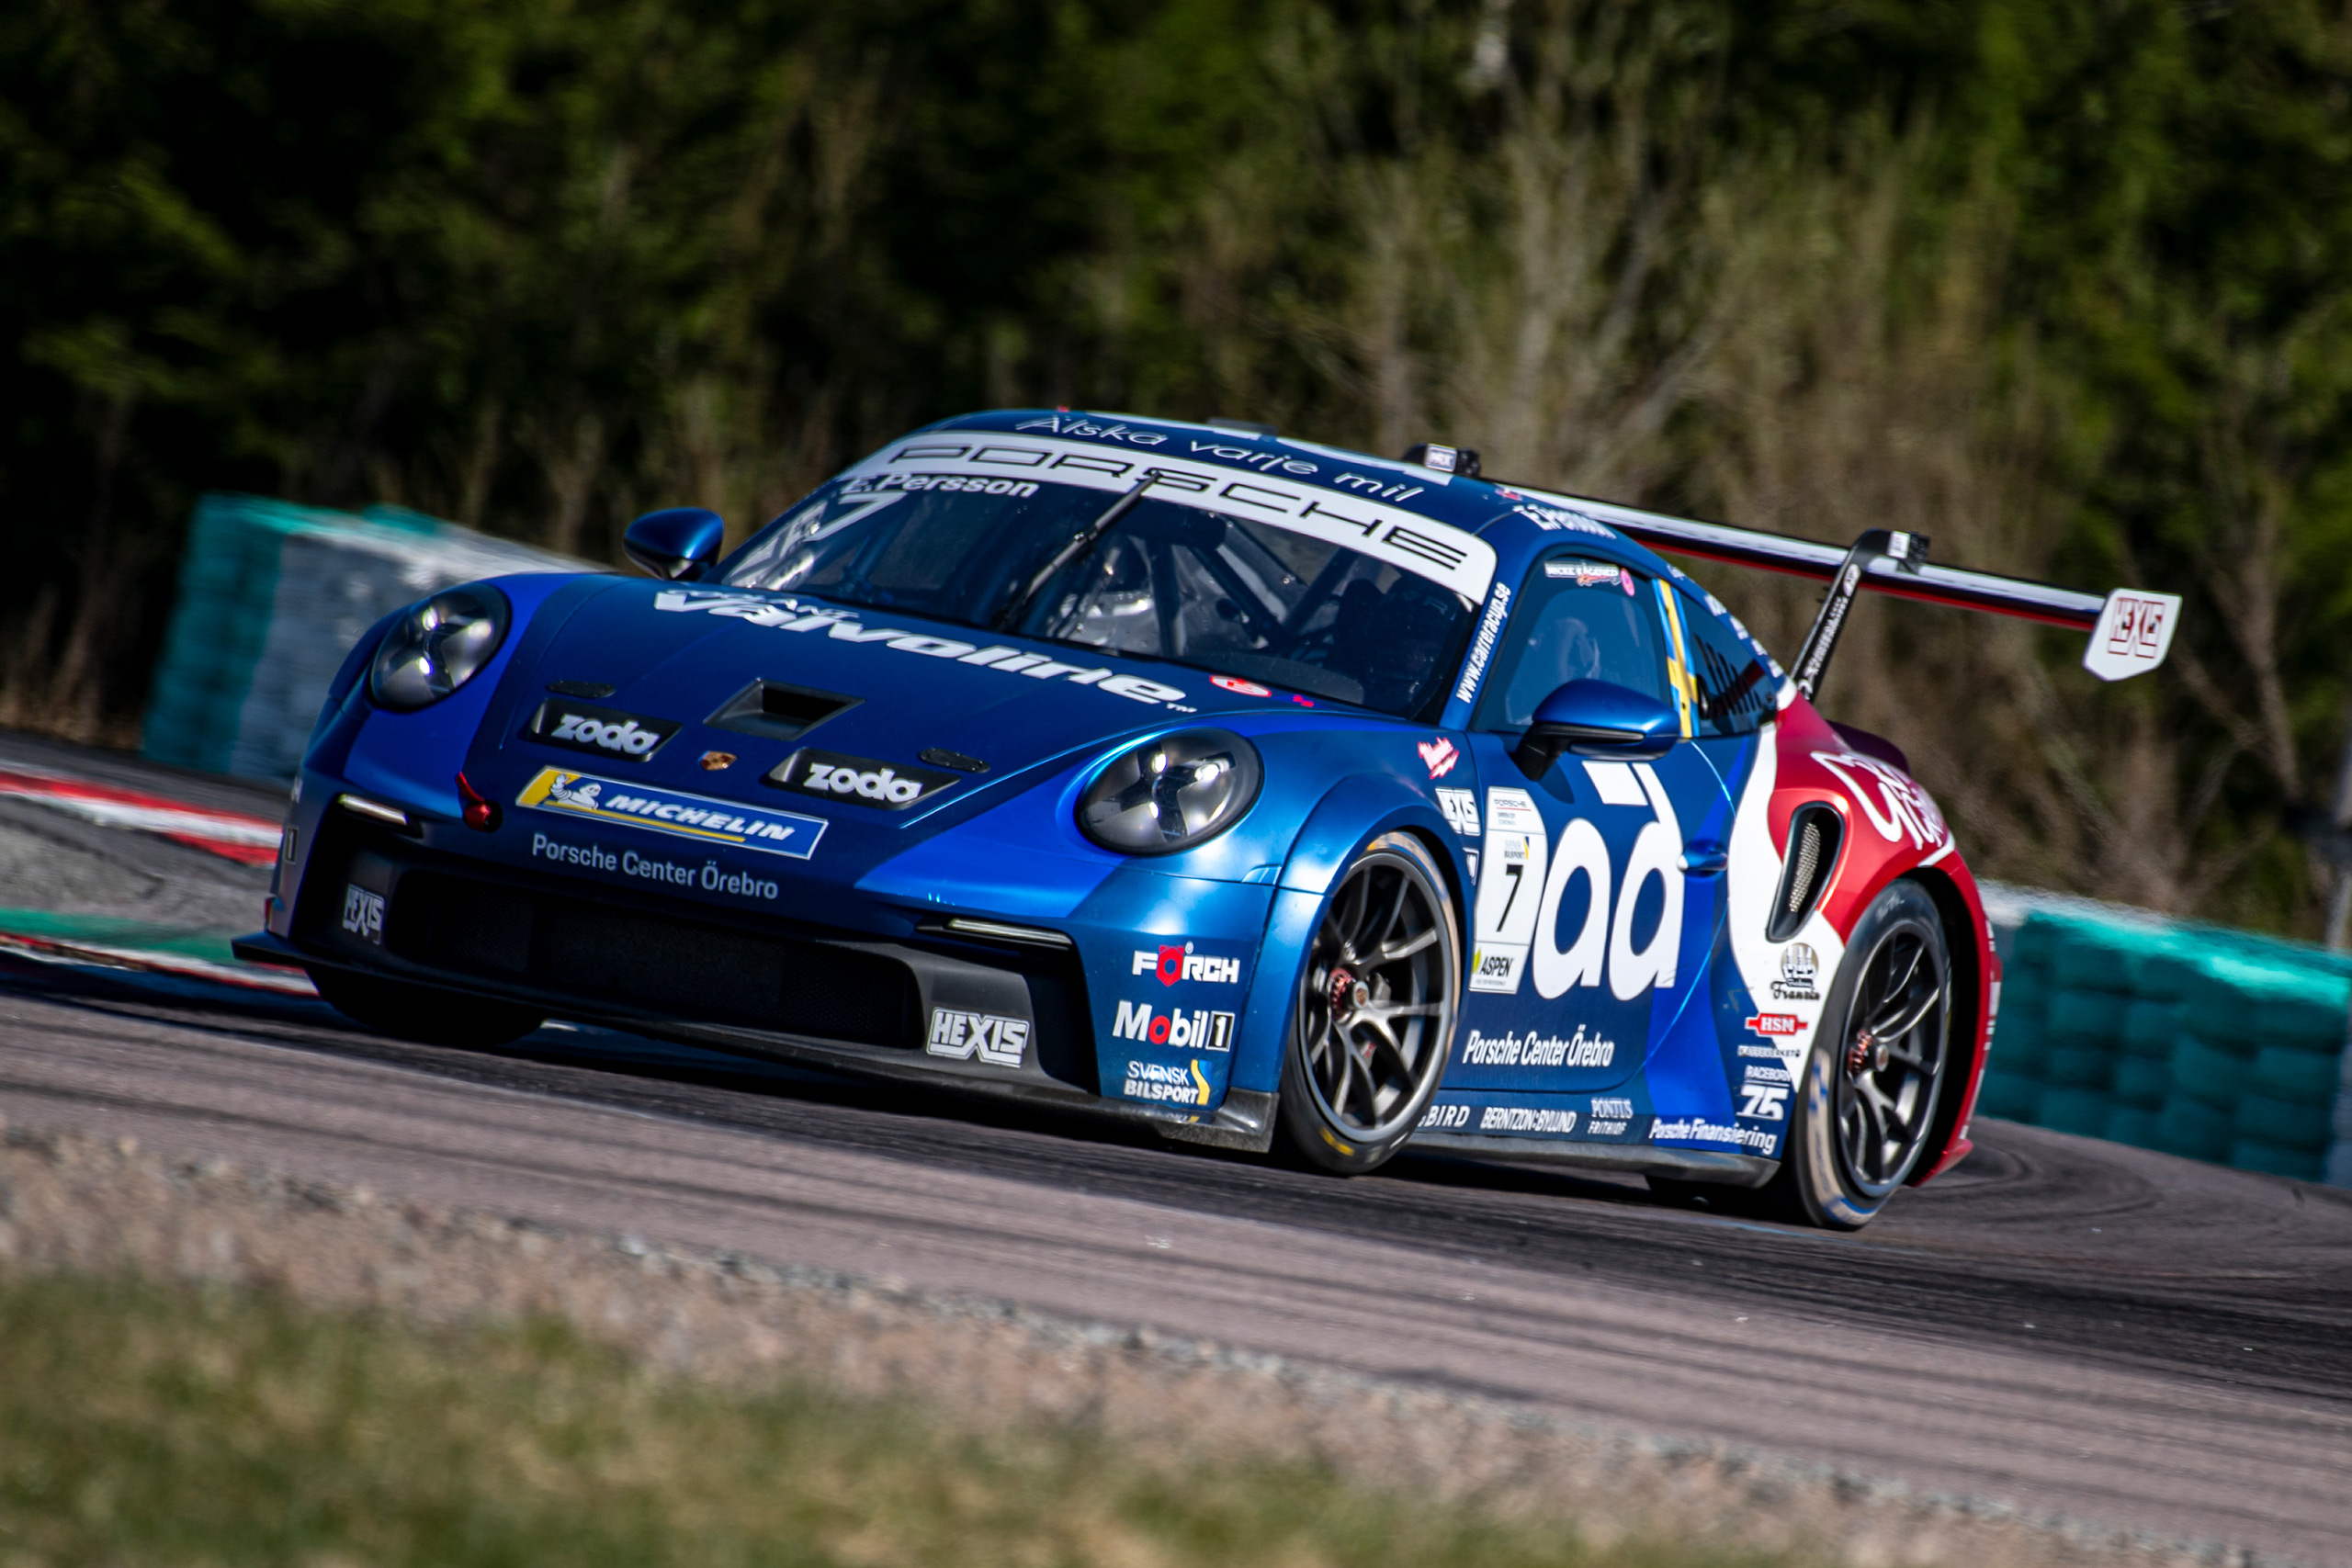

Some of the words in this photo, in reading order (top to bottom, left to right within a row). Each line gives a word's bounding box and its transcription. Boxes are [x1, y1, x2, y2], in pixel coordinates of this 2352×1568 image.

[1014, 415, 1168, 446] Älska
[1190, 440, 1318, 475] varje
[1333, 471, 1425, 502] mil
[888, 443, 1468, 571] PORSCHE
[1455, 581, 1511, 704] www.carreracup.se
[552, 713, 661, 755] zoda
[803, 761, 923, 804] zoda
[605, 795, 796, 840] MICHELIN
[532, 832, 616, 872] Porsche
[621, 850, 696, 887] Center
[700, 860, 779, 899] Örebro
[1496, 863, 1524, 932] 7
[1479, 956, 1514, 977] ASPEN
[930, 1010, 1029, 1066] HEXIS
[1112, 999, 1209, 1049] Mobil
[1463, 1030, 1521, 1066] Porsche
[1521, 1031, 1570, 1066] Center
[1566, 1024, 1615, 1067] Örebro
[1760, 1017, 1795, 1032] HSN
[1124, 1078, 1199, 1104] BILSPORT
[1126, 1061, 1190, 1086] SVENSK
[1648, 1117, 1690, 1140] Porsche
[1689, 1117, 1777, 1156] Finansiering
